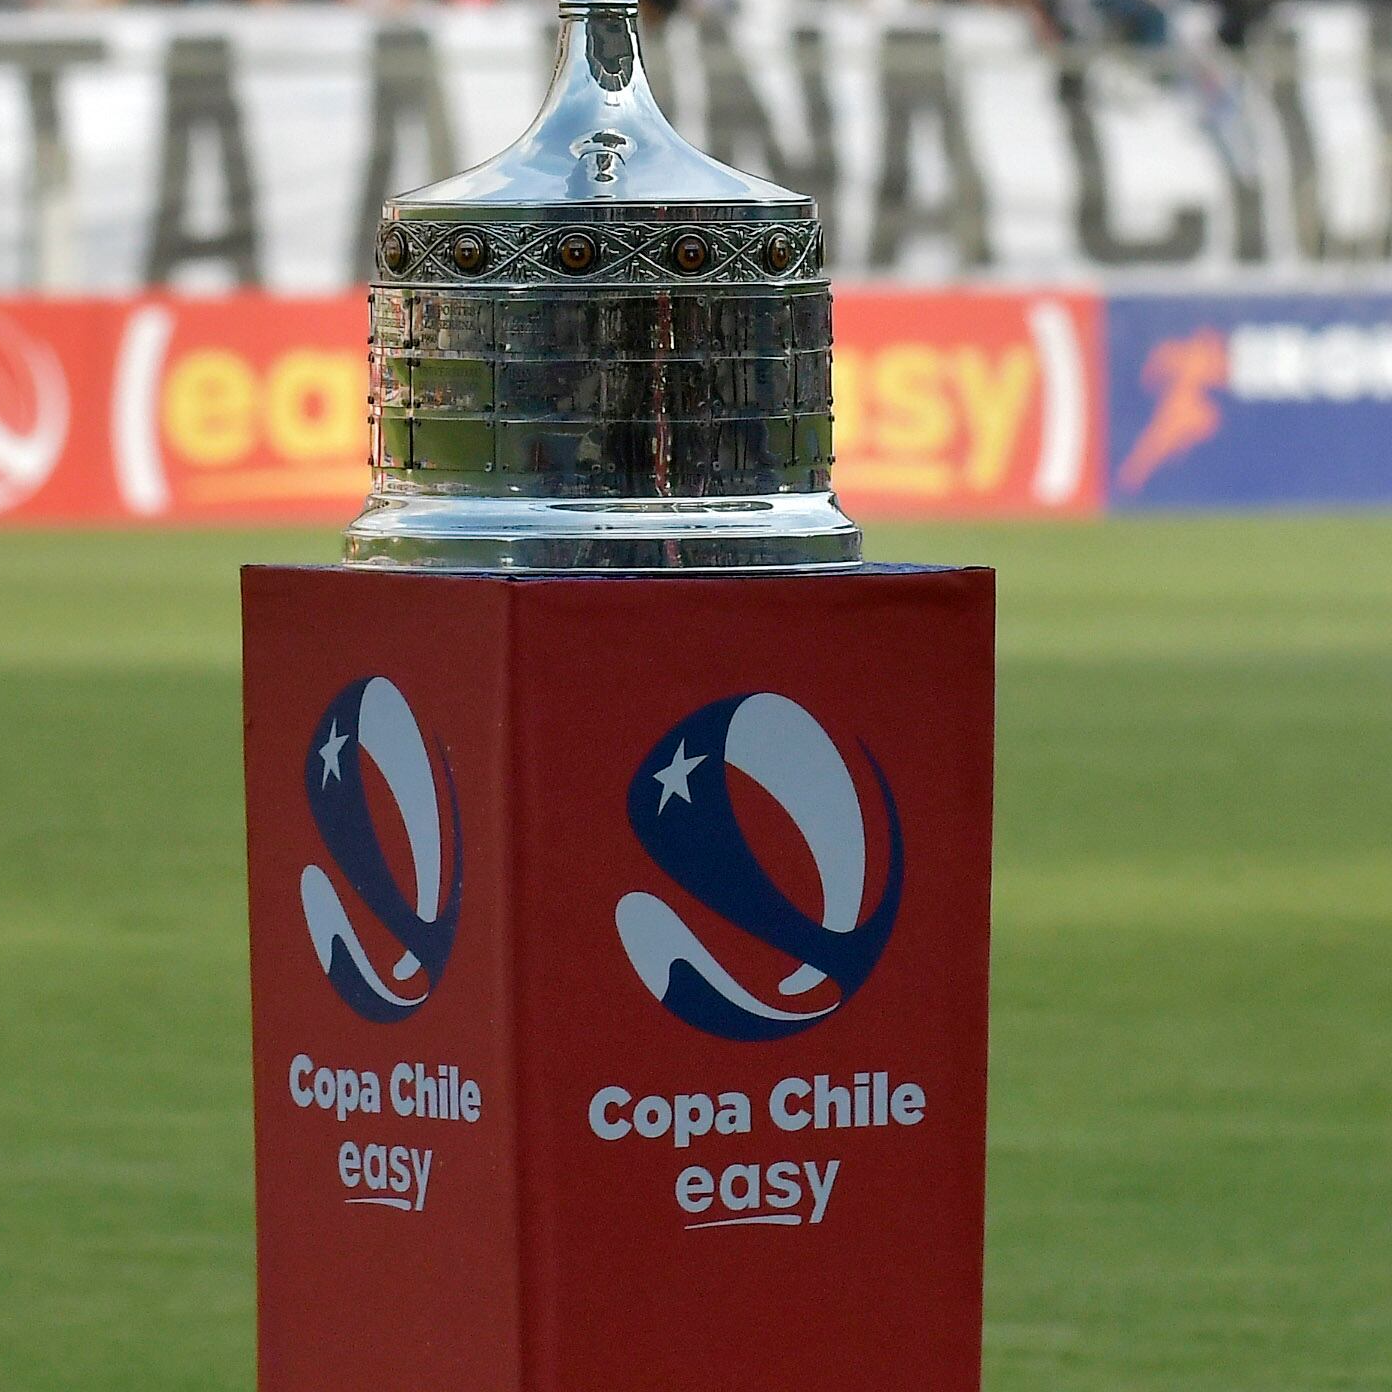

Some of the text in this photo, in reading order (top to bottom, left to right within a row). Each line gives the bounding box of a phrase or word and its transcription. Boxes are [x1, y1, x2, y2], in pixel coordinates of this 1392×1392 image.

[289, 1054, 482, 1123] Copa Chile
[588, 1072, 926, 1147] Copa Chile
[338, 1139, 433, 1211] easy
[674, 1158, 840, 1224] easy
